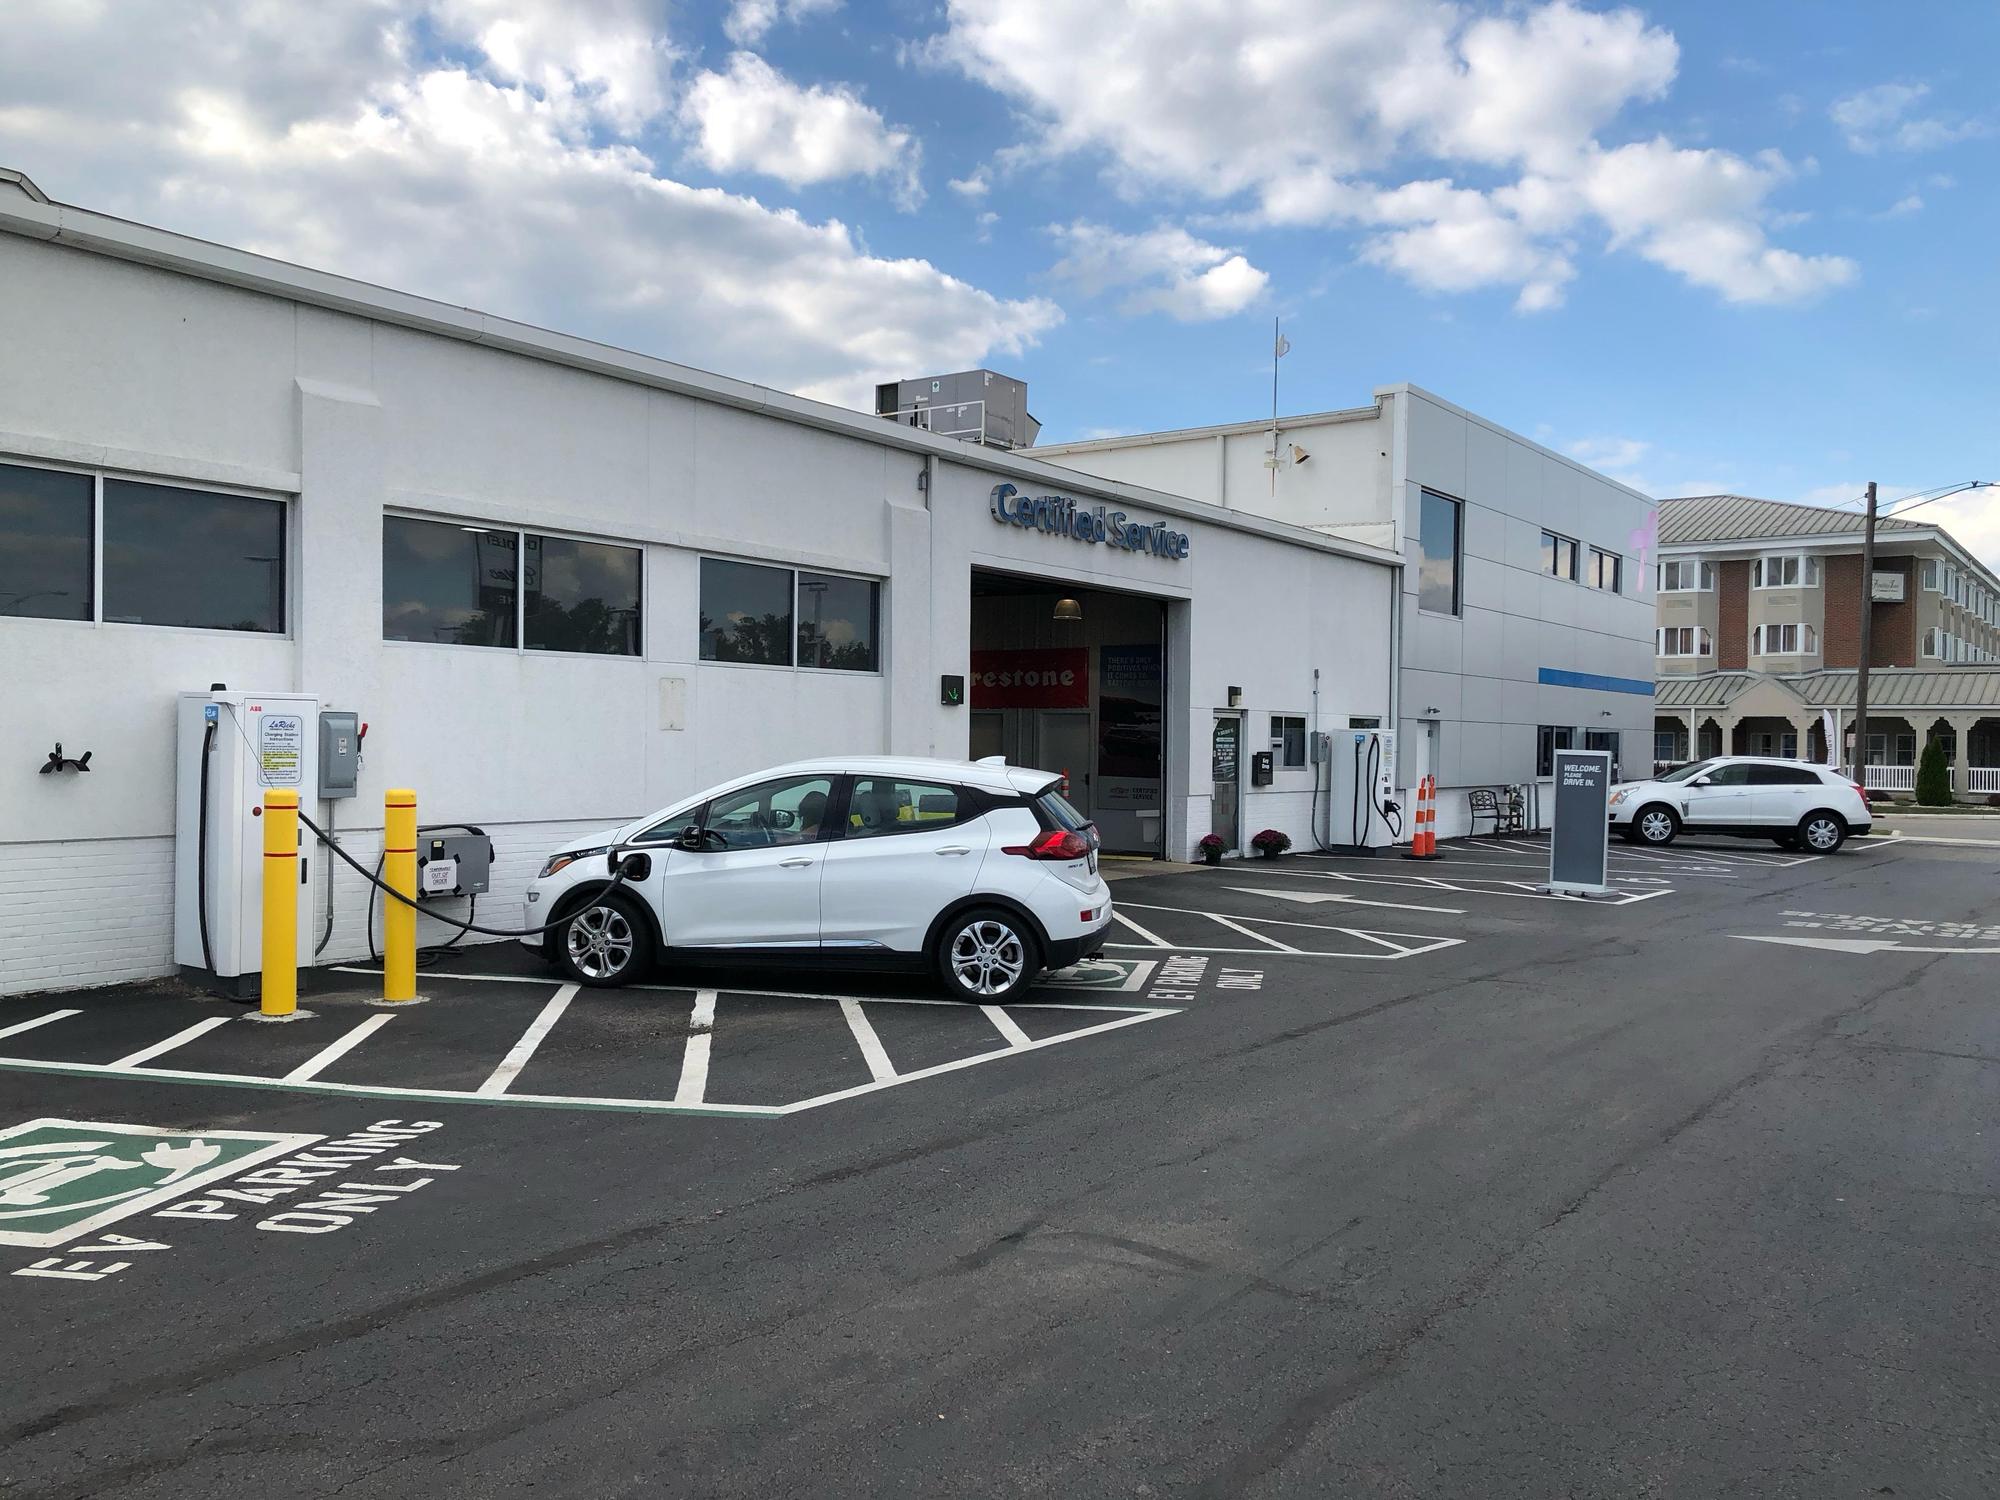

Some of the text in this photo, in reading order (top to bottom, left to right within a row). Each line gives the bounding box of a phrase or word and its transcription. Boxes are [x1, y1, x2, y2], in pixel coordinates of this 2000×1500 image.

[990, 483, 1190, 560] Certified Service
[970, 669, 1075, 688] restone
[1563, 778, 1595, 787] DRIVE IN.
[1154, 955, 1210, 986] PARKING
[1216, 967, 1264, 990] ONLY
[10, 1119, 444, 1281] EV PARKING
[256, 1157, 462, 1234] ONLY
